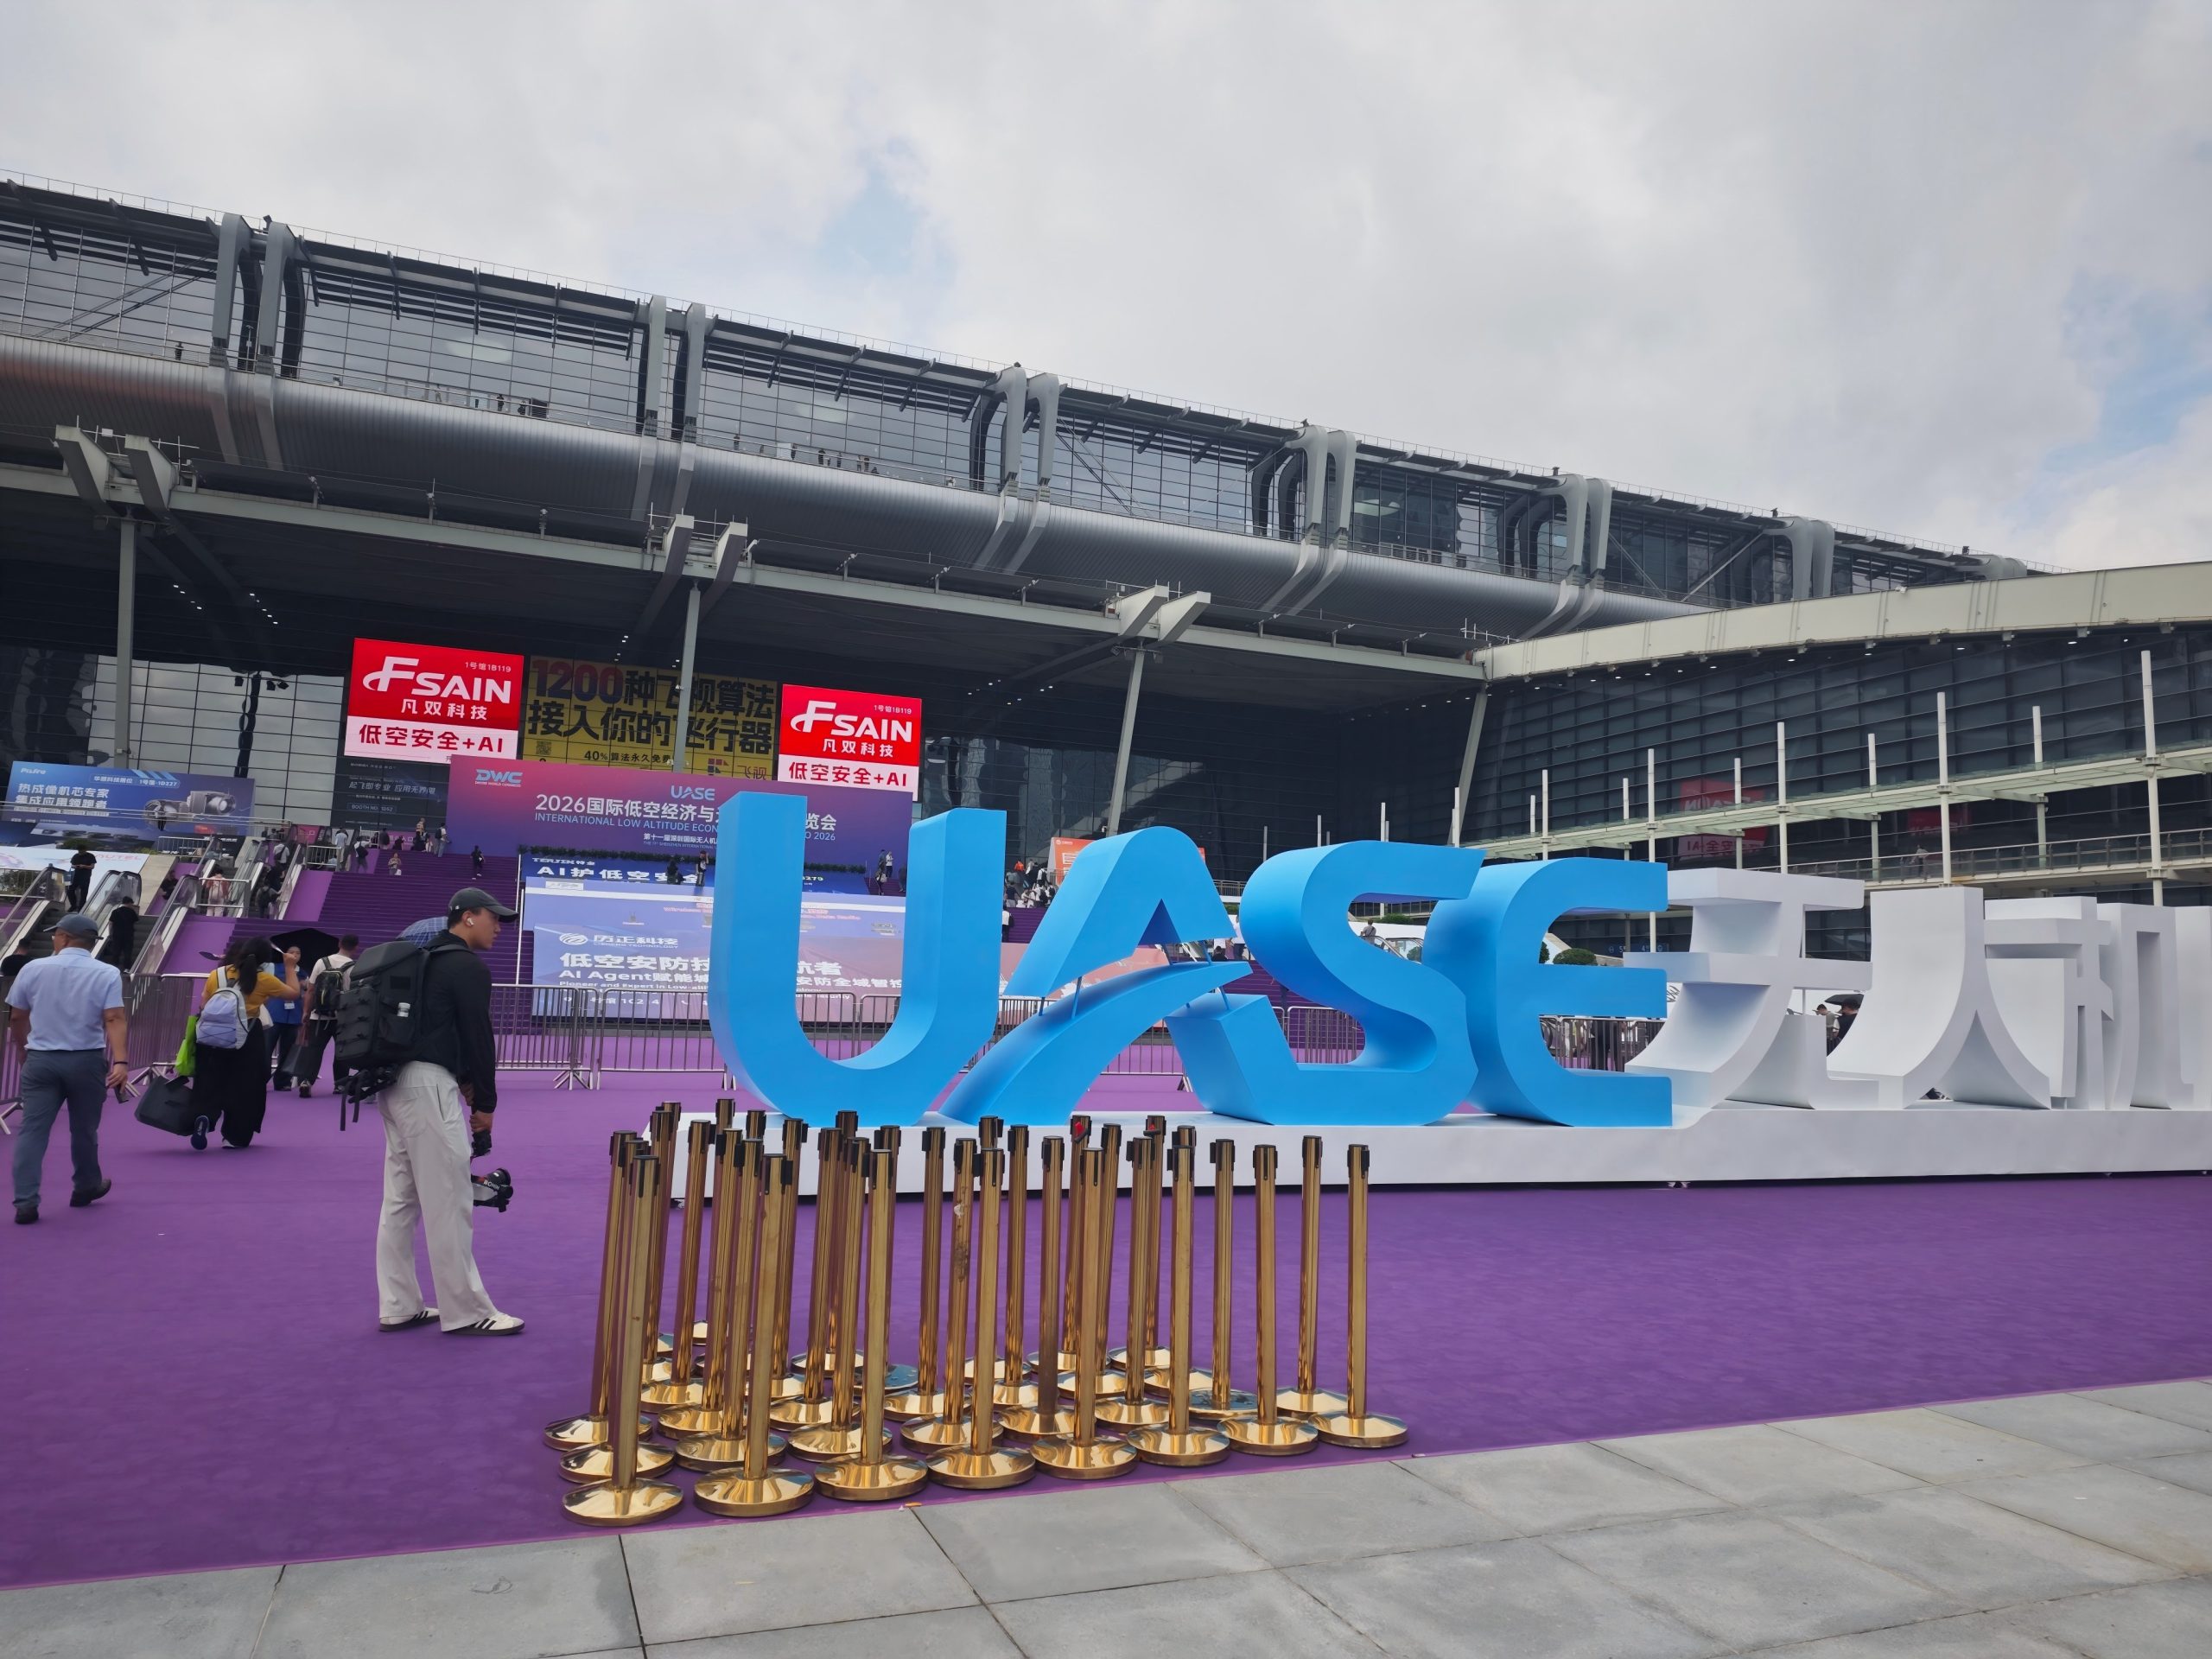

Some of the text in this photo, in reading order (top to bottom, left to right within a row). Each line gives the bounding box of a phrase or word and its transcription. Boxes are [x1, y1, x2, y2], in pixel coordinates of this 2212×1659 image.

[465, 661, 512, 673] 1号馆1B119
[362, 656, 512, 704] FSAIN
[401, 698, 487, 721] 凡双科技
[790, 700, 912, 743] FSAIN
[359, 724, 503, 753] 低空安全+AI
[823, 738, 893, 758] 凡双科技
[475, 768, 524, 784] DWC
[789, 761, 907, 787] 低空安全+AI
[17, 782, 110, 799] 热成像机芯专家
[670, 785, 715, 801] UASE
[535, 794, 719, 823] 2026国际低空经济与
[535, 812, 614, 826] INTERNATIONAL
[618, 818, 640, 829] LOW
[643, 820, 690, 831] ALTITUDE
[814, 831, 836, 841] 2026
[708, 791, 1673, 1127] UASE
[558, 969, 582, 979] AI
